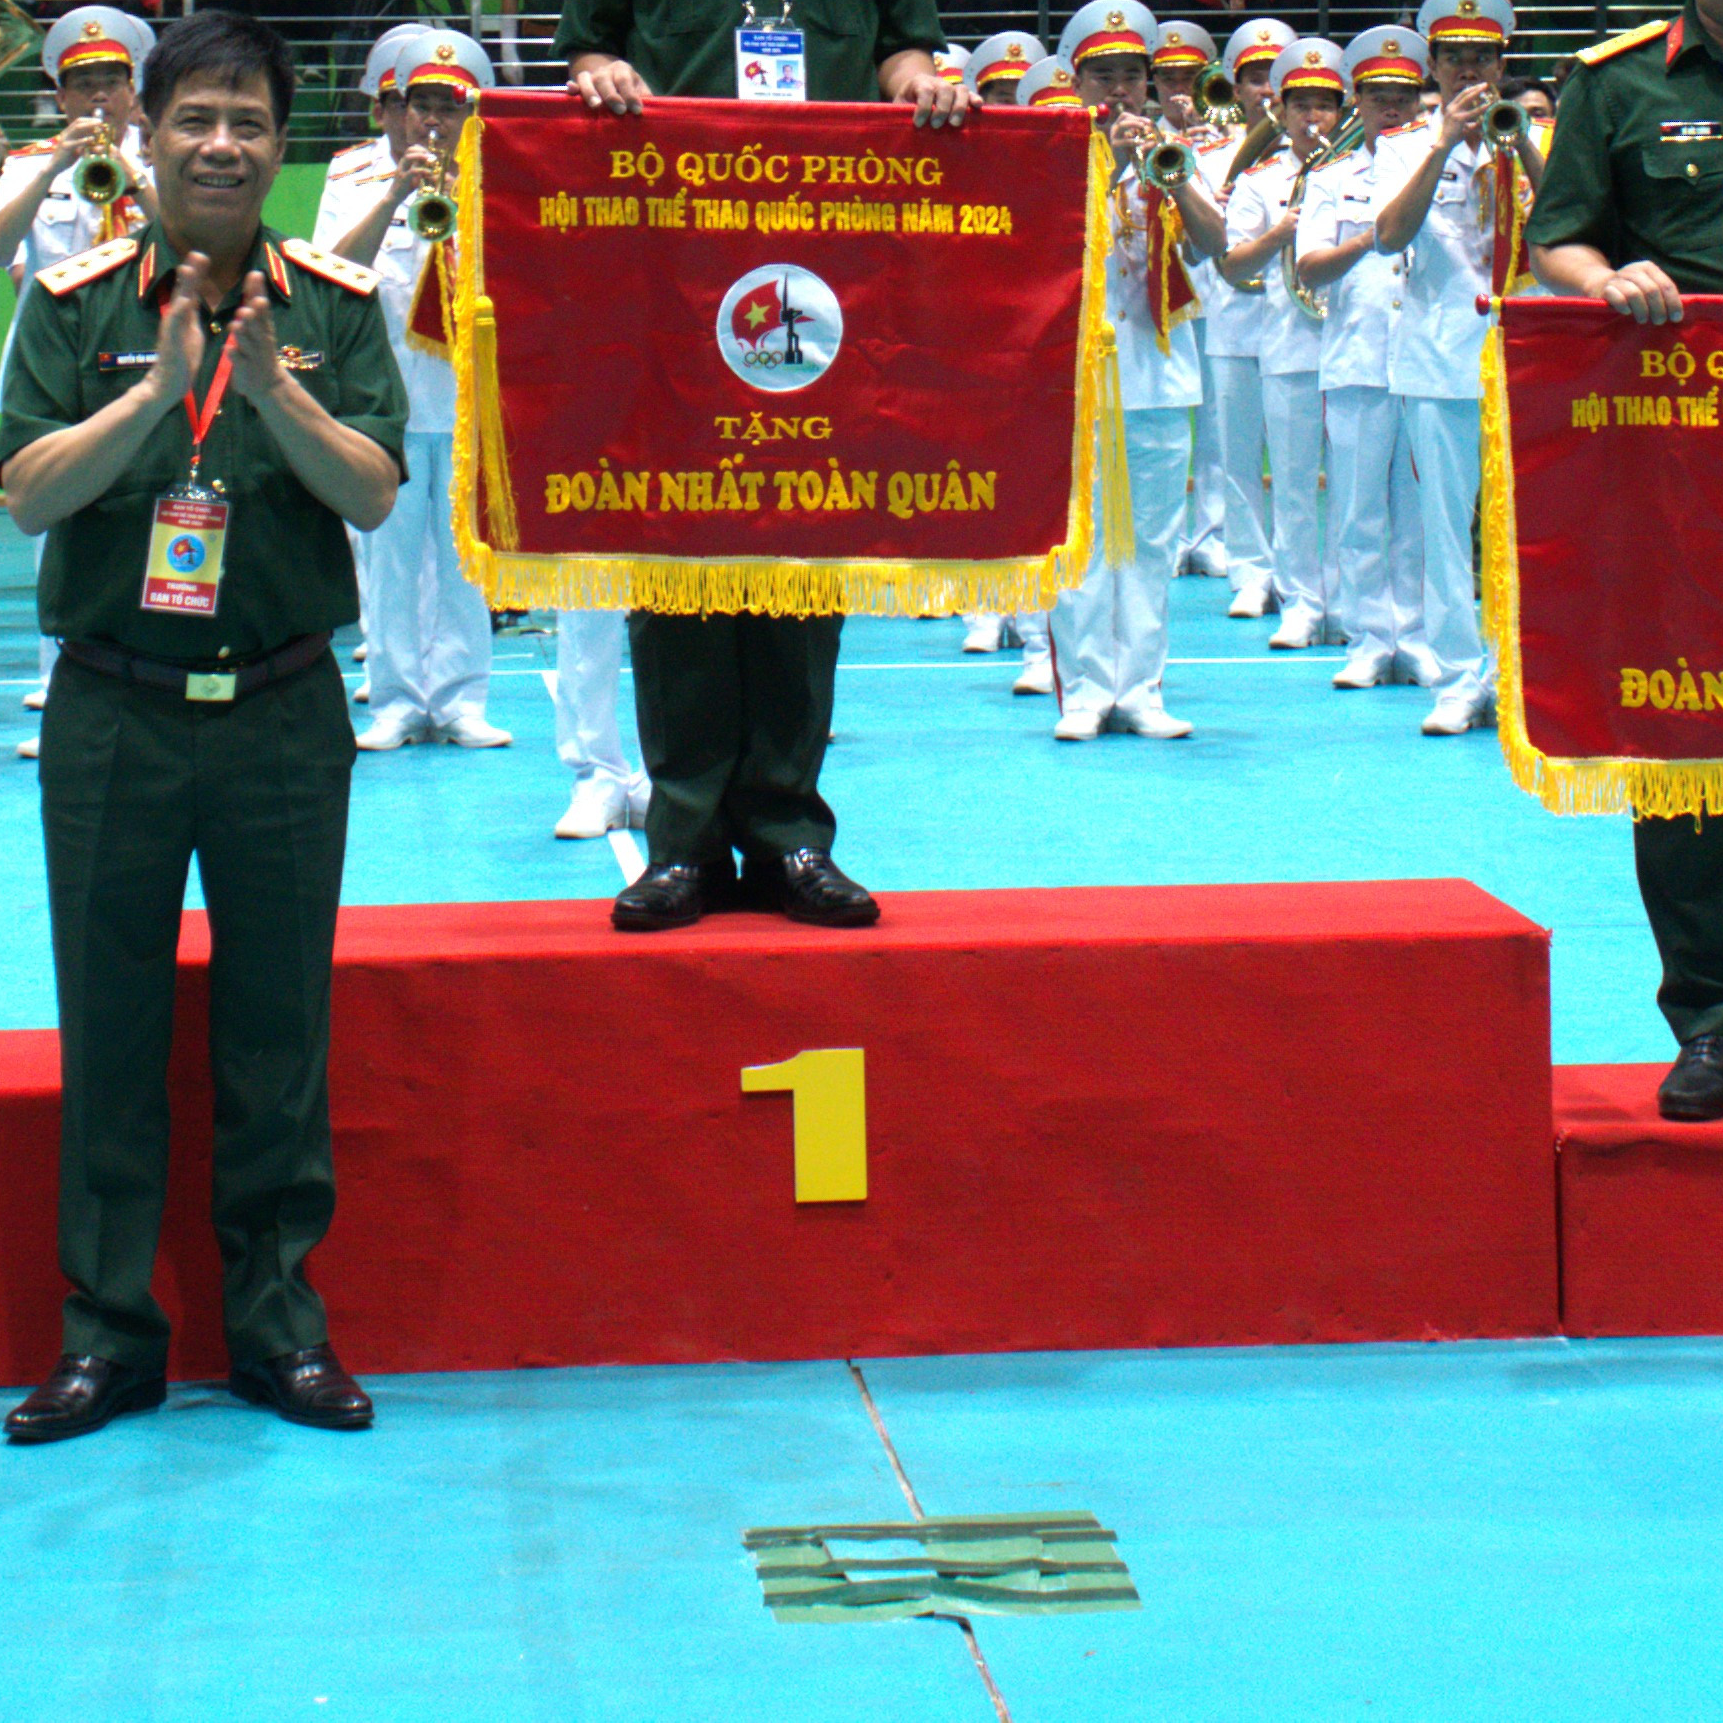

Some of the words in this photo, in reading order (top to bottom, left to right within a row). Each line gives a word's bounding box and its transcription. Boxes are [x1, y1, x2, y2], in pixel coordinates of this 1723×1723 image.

[610, 143, 664, 186] BỘ
[676, 143, 790, 183] QUỐC
[802, 150, 944, 185] PHÒNG
[540, 192, 579, 233] HỘI
[584, 196, 640, 226] THAO
[646, 188, 687, 227] THỂ
[692, 198, 749, 230] THAO
[755, 192, 815, 234] QUỐC
[821, 196, 896, 231] PHÒNG
[901, 201, 954, 233] NĂM
[960, 204, 1012, 234] 2024
[1640, 343, 1695, 386] BỘ
[714, 412, 833, 444] TẶNG
[1572, 392, 1608, 433] HỘI
[1613, 395, 1672, 425] THAO
[1678, 385, 1720, 425] THỂ
[545, 458, 650, 514] ĐOÀN
[659, 453, 765, 512] NHẤT
[773, 458, 879, 511] TOÀN
[886, 461, 997, 518] QUÂN
[741, 1048, 867, 1203] 1
